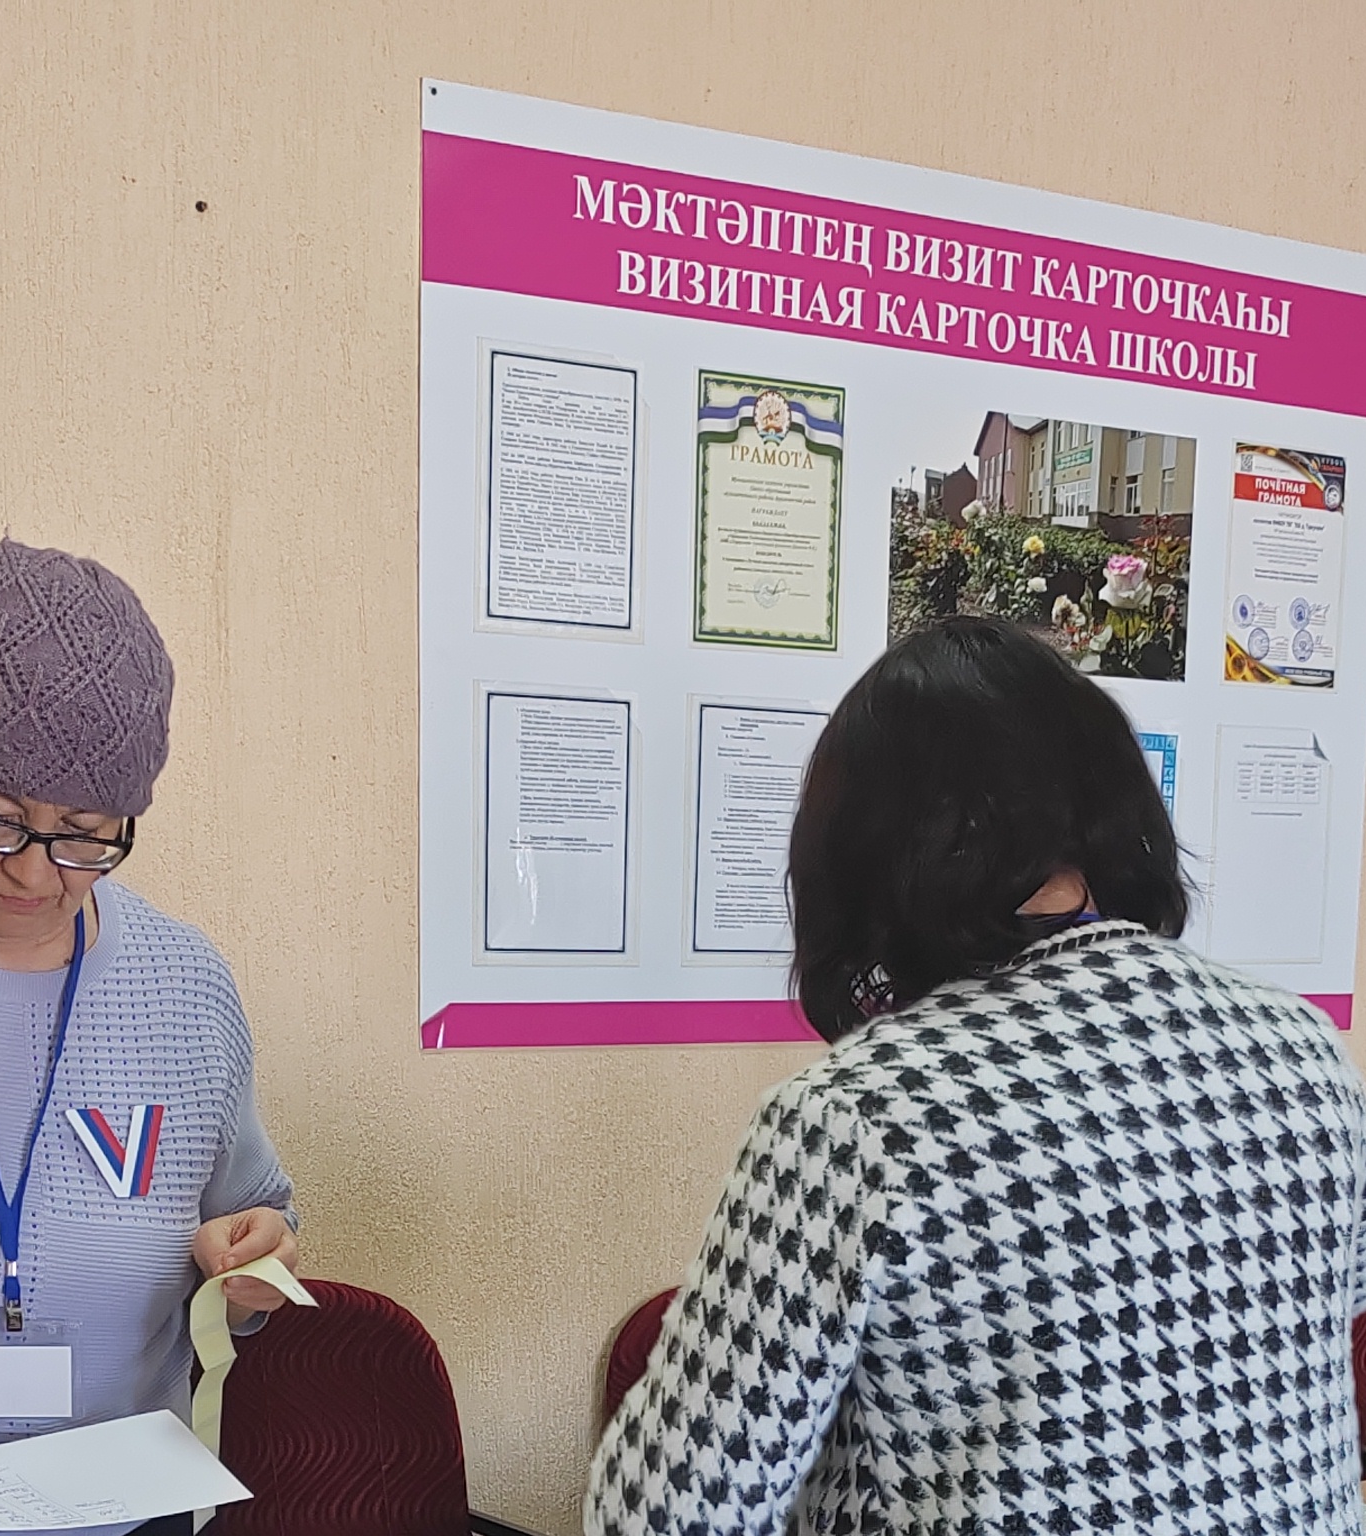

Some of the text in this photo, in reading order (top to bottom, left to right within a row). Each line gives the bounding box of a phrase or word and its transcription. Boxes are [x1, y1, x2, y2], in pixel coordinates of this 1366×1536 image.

[572, 174, 875, 278] МӘКТӘПТЕҢ
[883, 229, 1023, 292] ВИЗИТ
[616, 249, 1258, 390] ВИЗИТНАЯ КАРТОЧКА ШКОЛЫ
[729, 444, 815, 471] ГРАМОТА
[1255, 477, 1306, 495] ПОЧЁТНАЯ
[1257, 492, 1303, 508] ГРАМОТА
